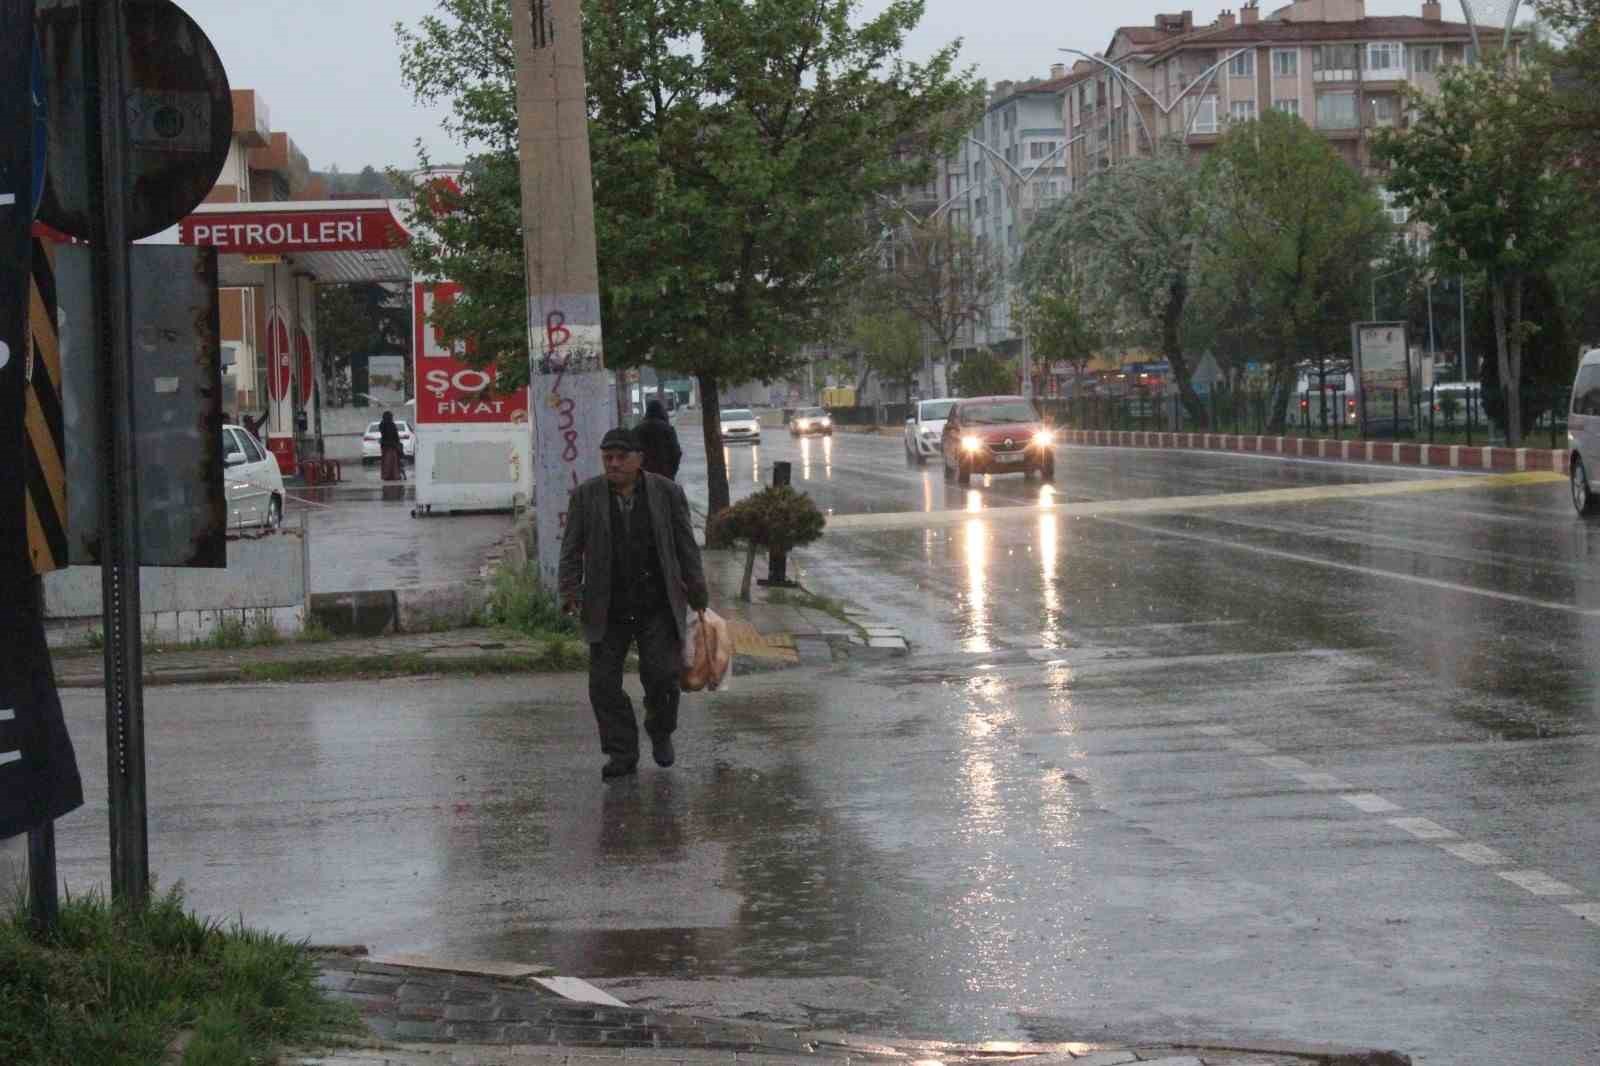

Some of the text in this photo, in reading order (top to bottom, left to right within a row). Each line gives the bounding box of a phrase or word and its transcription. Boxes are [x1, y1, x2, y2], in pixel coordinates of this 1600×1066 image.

[193, 216, 363, 246] PETROLLERİ
[425, 369, 505, 399] ŞO
[437, 399, 504, 415] FİYAT
